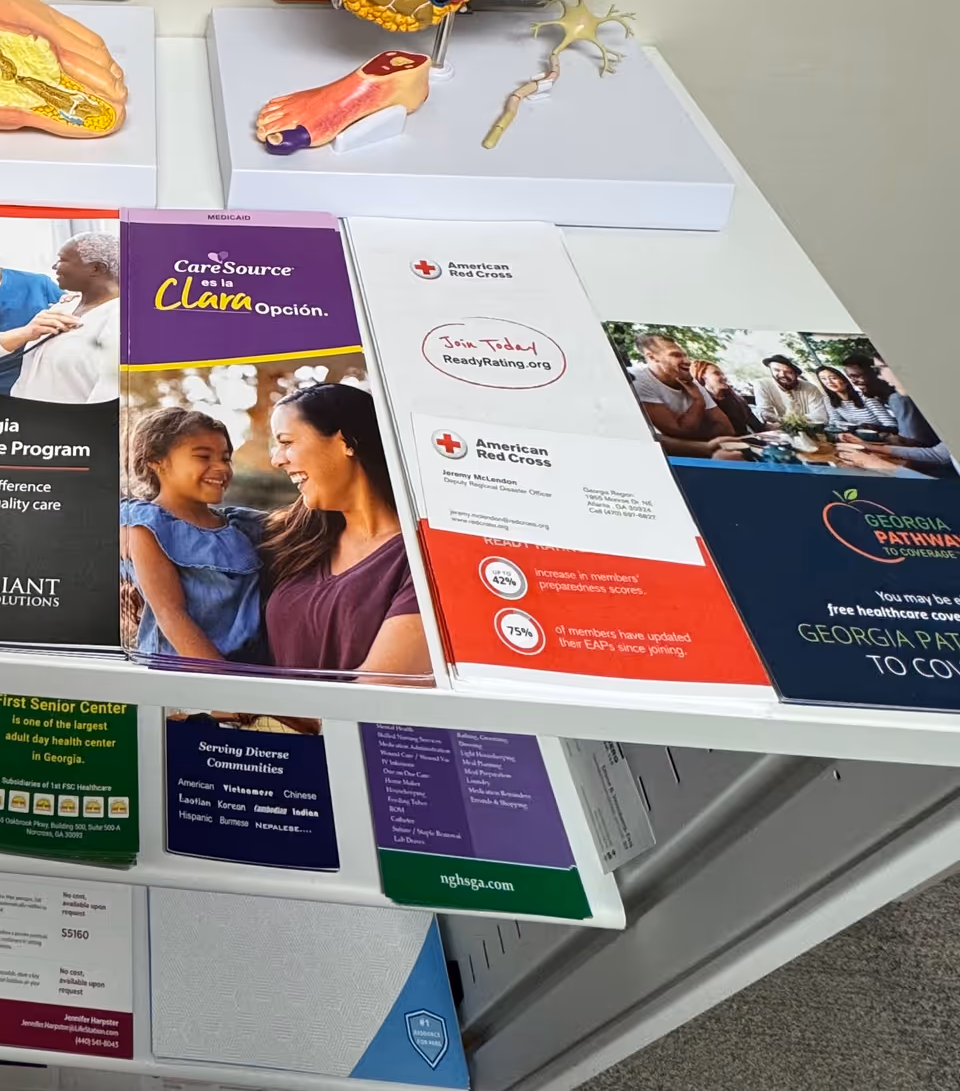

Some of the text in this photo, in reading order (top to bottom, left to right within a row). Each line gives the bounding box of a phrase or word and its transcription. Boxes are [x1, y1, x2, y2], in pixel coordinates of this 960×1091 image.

[174, 260, 293, 276] CareSource
[448, 262, 509, 271] American
[449, 270, 513, 279] Red Cross
[221, 279, 233, 287] la
[155, 277, 329, 317] Clara Opción.
[439, 336, 537, 356] Join Today
[443, 354, 552, 370] ReadyRating.org
[11, 442, 90, 460] Program
[476, 438, 548, 456] American
[477, 449, 552, 467] Red Cross
[33, 499, 61, 511] care
[864, 514, 952, 531] GEORGIA
[884, 547, 899, 556] TO
[492, 576, 517, 586] 42%
[535, 568, 639, 583] increase in members'
[539, 581, 646, 595] preparedness scores.
[875, 591, 952, 606] You may be
[827, 603, 960, 621] free healthcare cove
[506, 625, 533, 638] 75%
[555, 625, 691, 643] of members have updated
[798, 624, 960, 651] GEORGIA PAT
[559, 638, 687, 658] their EAPs since joining.
[866, 655, 907, 675] TO
[30, 697, 76, 713] Senior
[80, 701, 127, 714] Center
[12, 715, 108, 732] is one of the largest
[5, 732, 116, 747] adult day health center
[32, 751, 85, 765] in Georgia.
[199, 741, 289, 759] Serving Diverse
[207, 758, 284, 774] Communities
[178, 778, 317, 800] American Vietnamese Chinese
[179, 793, 319, 817] Laotian Korean Indian
[179, 811, 249, 827] Hispanic Burmese
[440, 874, 514, 892] nghsga.com
[62, 928, 89, 940] S5160
